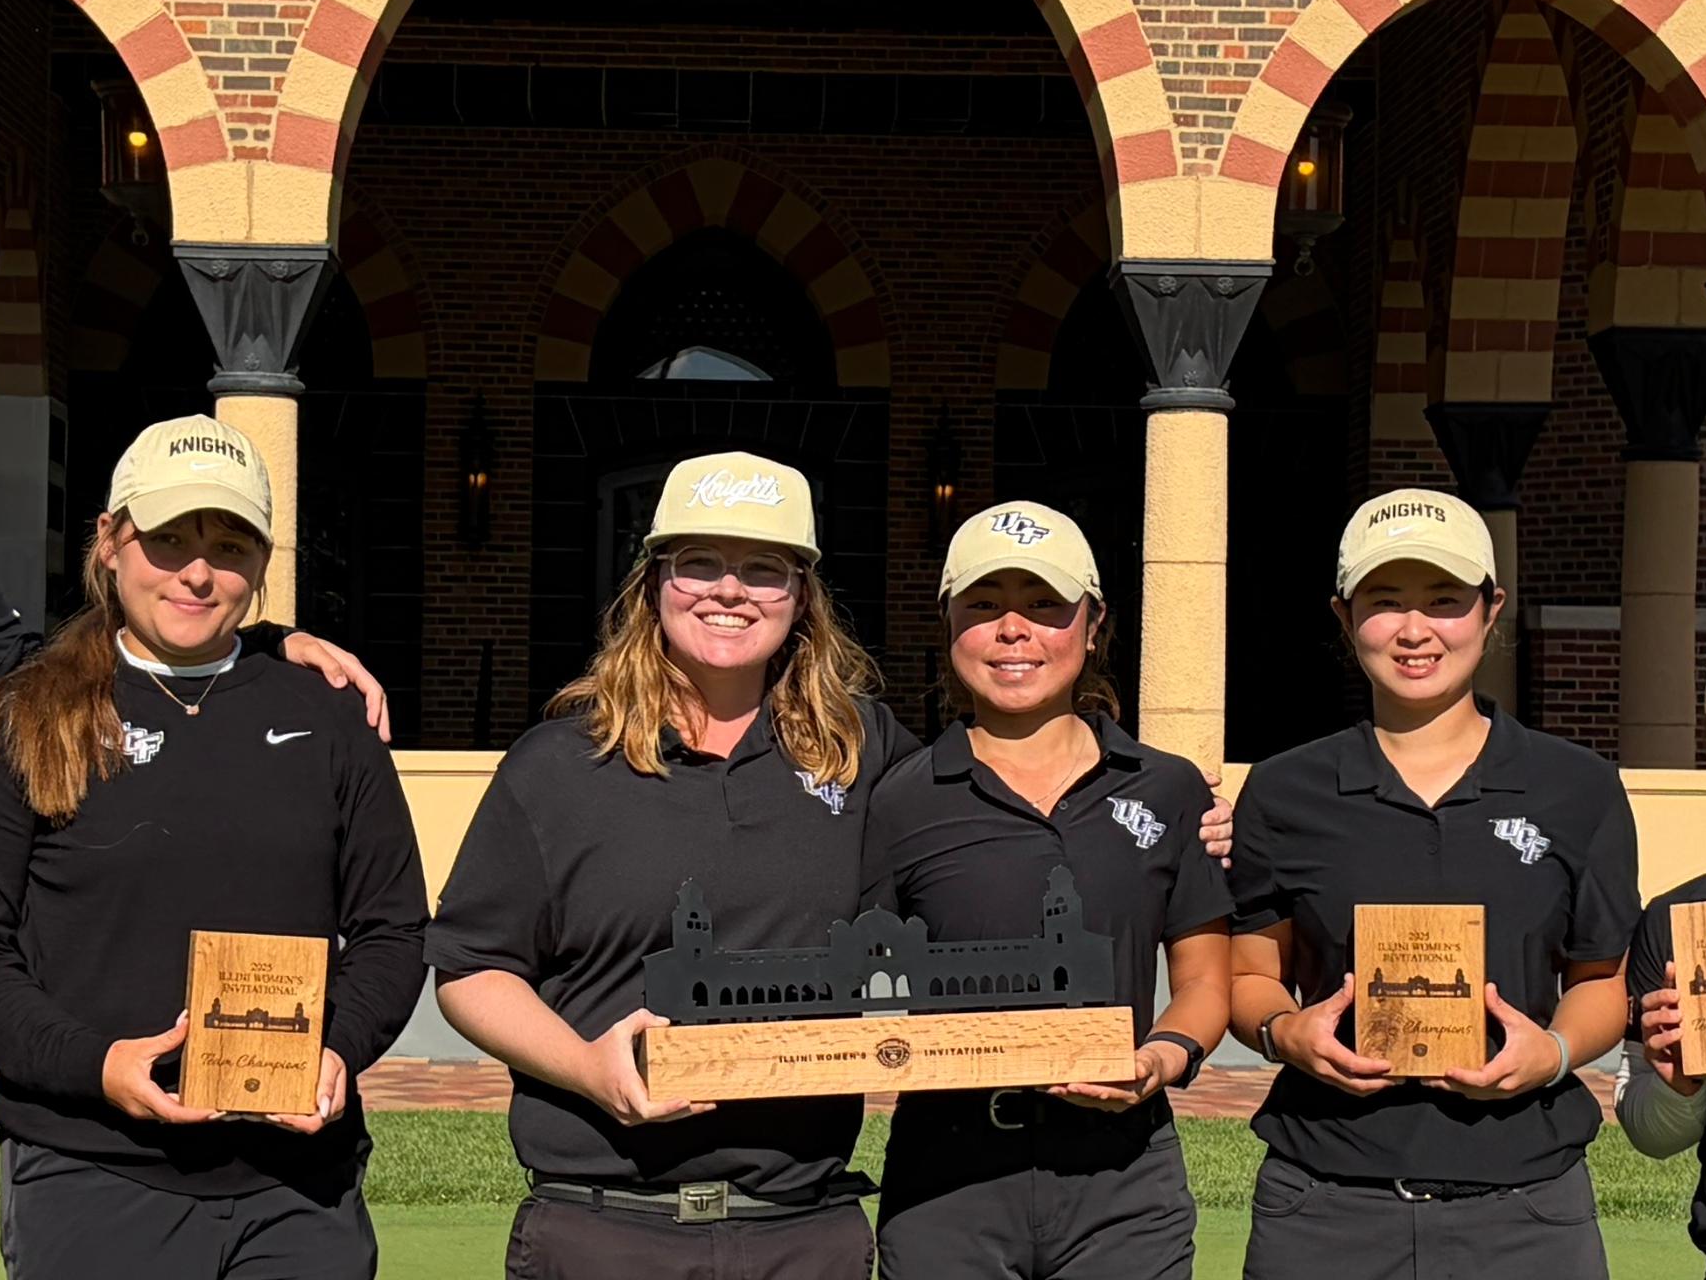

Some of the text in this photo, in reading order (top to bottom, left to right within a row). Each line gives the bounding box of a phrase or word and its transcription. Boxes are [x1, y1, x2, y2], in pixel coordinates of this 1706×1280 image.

[169, 436, 247, 468] KNIGHTS
[685, 469, 787, 509] Knights
[991, 511, 1050, 545] UCF
[1367, 502, 1446, 529] KNIGHTS
[117, 721, 164, 764] CF
[1106, 797, 1167, 849] UCF
[1488, 816, 1551, 864] UCF
[222, 984, 298, 996] INVITATIONAL
[1403, 1020, 1473, 1039] Champions
[235, 1054, 308, 1076] Champions
[924, 1046, 1006, 1057] INVITATIONAL
